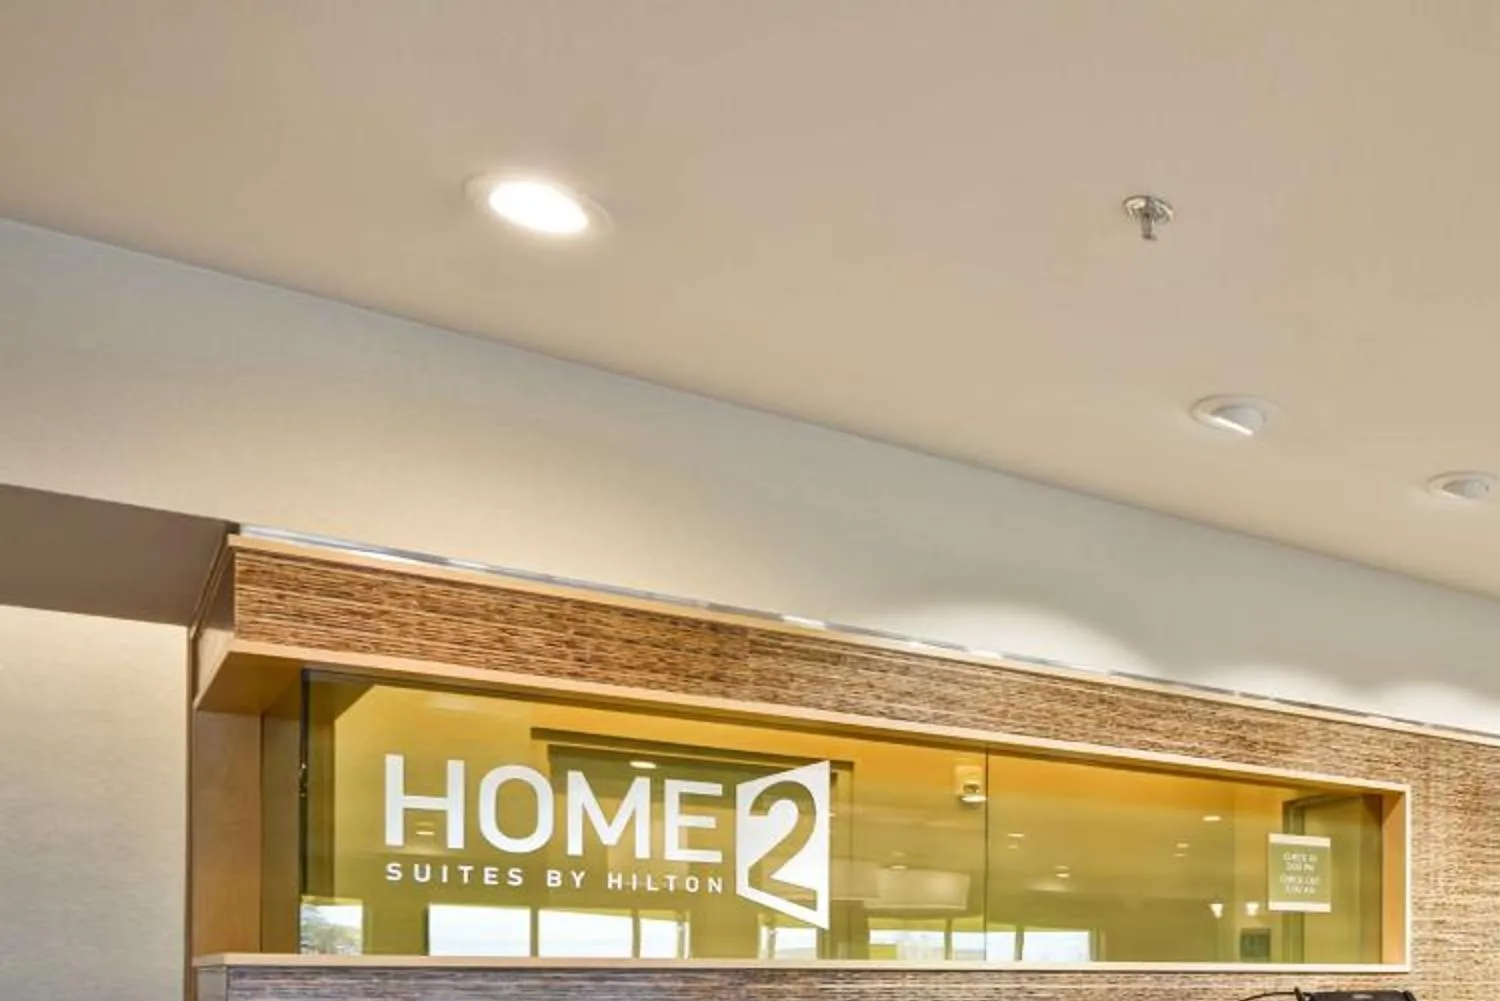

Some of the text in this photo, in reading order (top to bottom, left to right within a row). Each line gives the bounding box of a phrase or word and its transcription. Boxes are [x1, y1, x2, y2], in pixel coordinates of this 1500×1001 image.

[385, 862, 723, 893] SUITES BY HILTON
